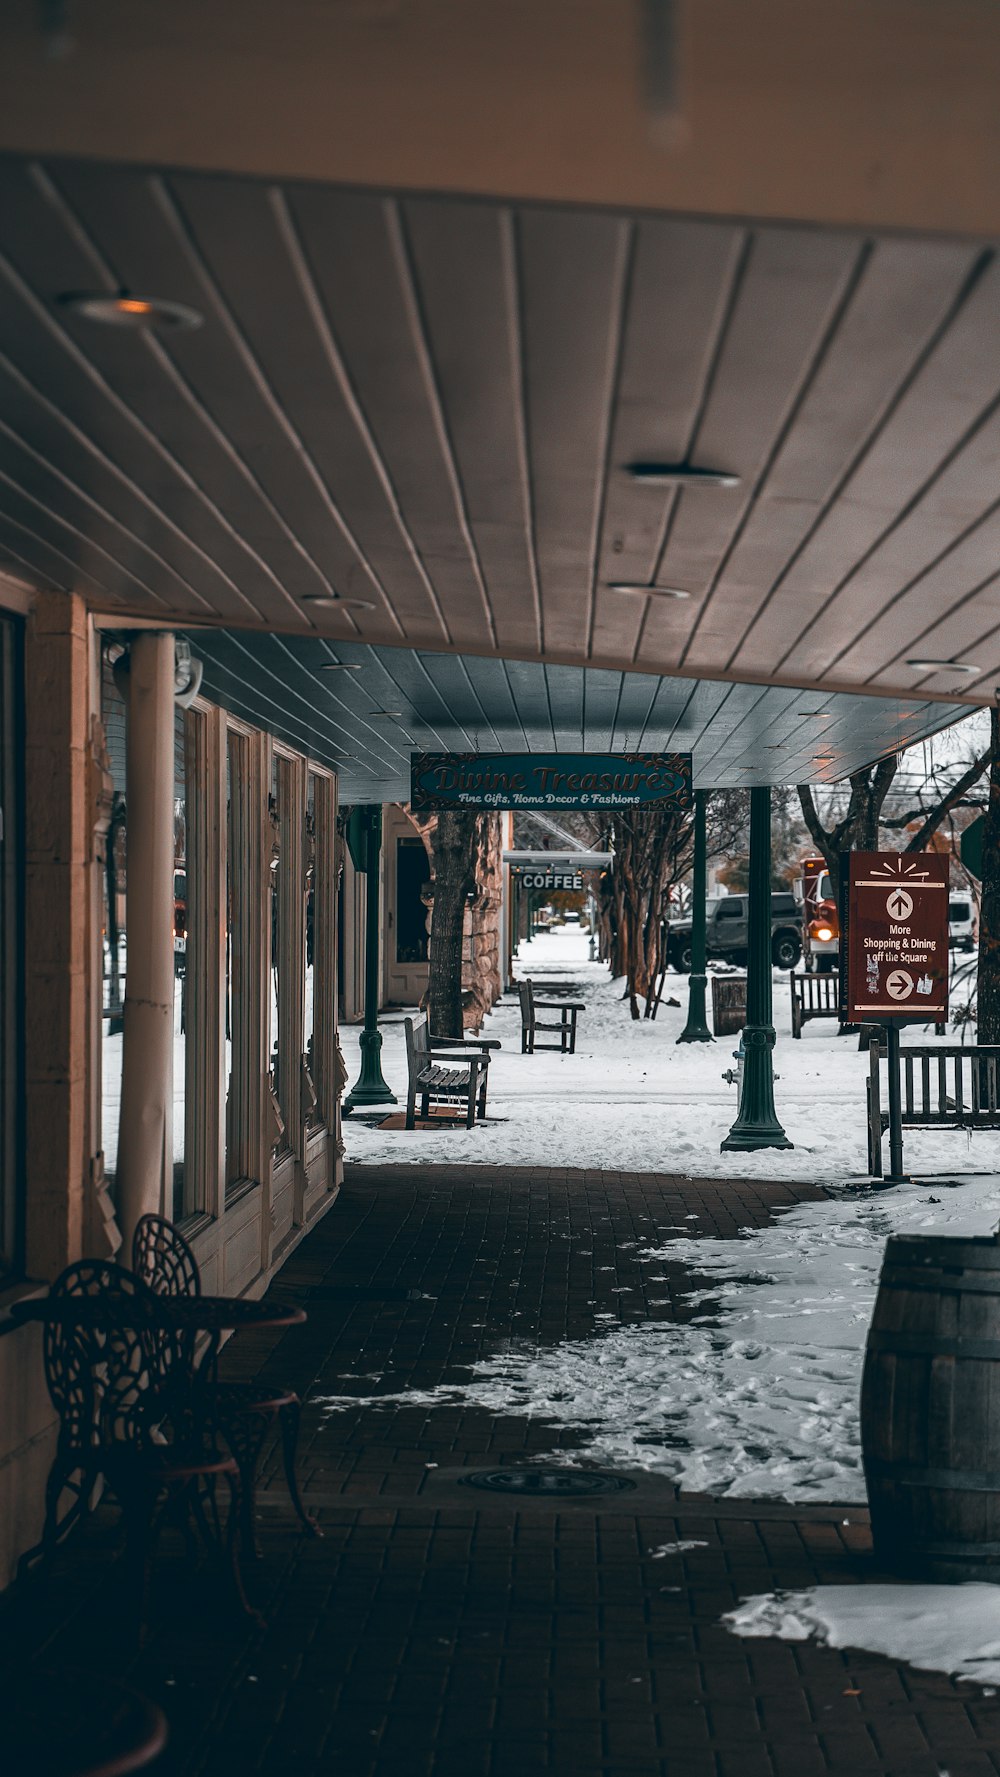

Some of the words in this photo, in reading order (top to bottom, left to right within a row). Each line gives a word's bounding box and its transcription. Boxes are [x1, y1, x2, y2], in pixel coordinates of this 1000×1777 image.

[434, 766, 527, 791] Divine
[533, 766, 677, 792] Treasures
[458, 793, 482, 803] Fine
[484, 793, 510, 807] Gifts,
[512, 793, 545, 803] Home
[545, 793, 577, 804] Decor
[580, 793, 590, 804] &
[591, 793, 640, 804] Fashions
[523, 875, 582, 889] COFFEE
[889, 924, 911, 935] More
[863, 938, 900, 951] Shopping
[902, 939, 909, 949] &
[910, 938, 936, 951] Dining
[872, 952, 885, 962] off
[885, 952, 899, 962] the
[900, 952, 928, 964] Square
